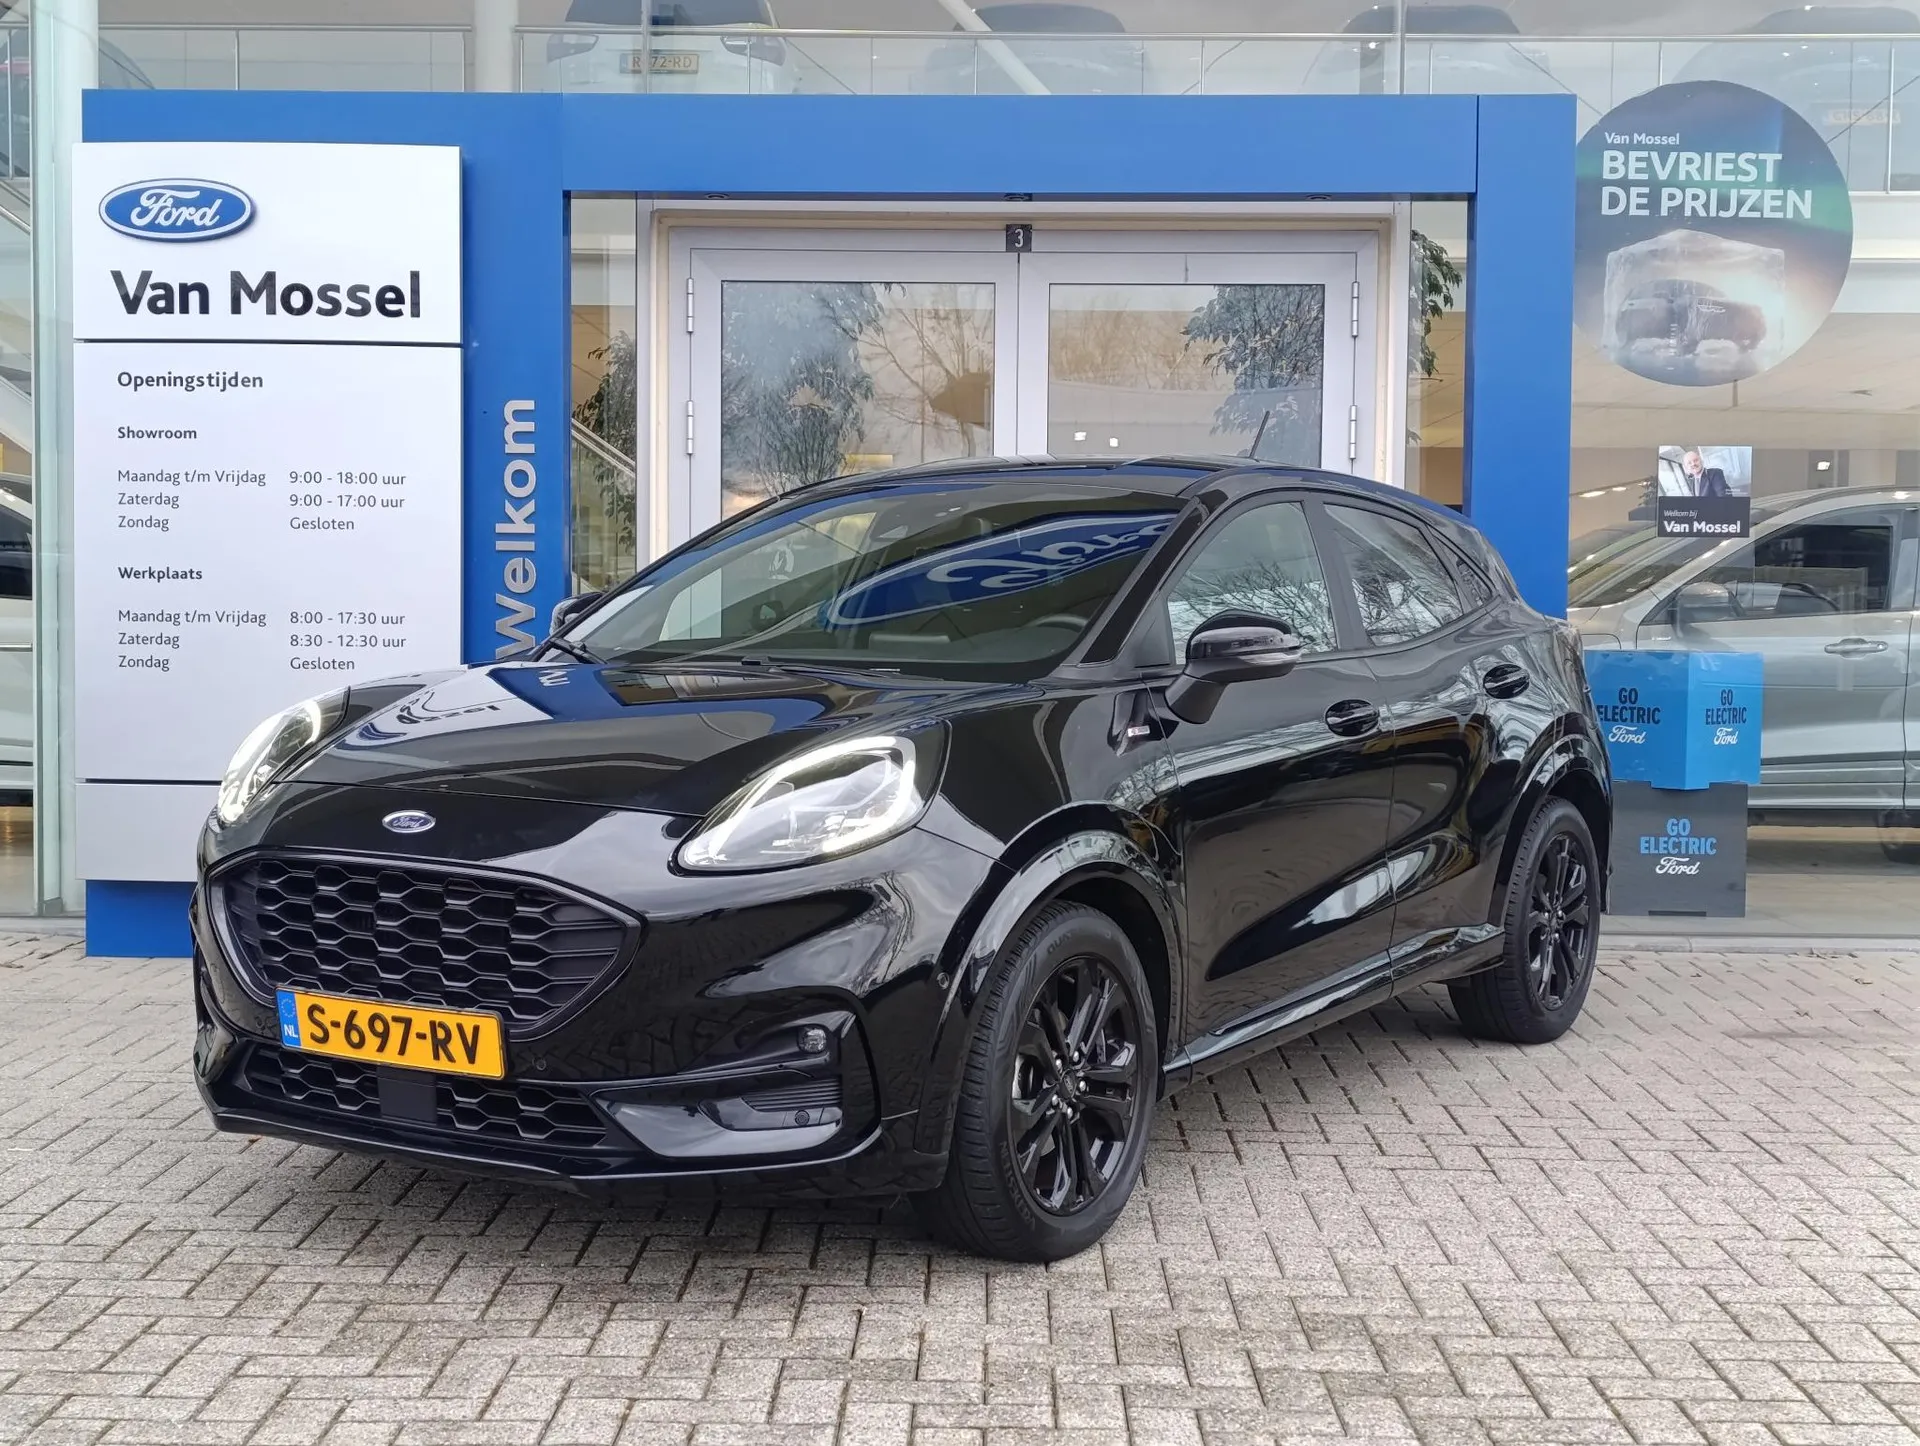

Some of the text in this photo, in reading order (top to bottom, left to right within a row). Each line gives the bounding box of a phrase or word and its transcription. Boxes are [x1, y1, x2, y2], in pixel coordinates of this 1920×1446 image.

[1604, 132, 1680, 145] Van Mossel
[1602, 150, 1783, 183] BEVRIEST
[130, 189, 223, 227] Ford
[1601, 186, 1813, 219] DE PRIJZEN
[1014, 228, 1024, 248] 3
[109, 269, 421, 319] Van Mossel
[116, 370, 264, 390] Openingstijden
[117, 425, 198, 441] Showroom
[117, 468, 181, 487] Maandag
[183, 469, 211, 485] t/m
[214, 469, 267, 489] Vrijdag
[288, 470, 323, 486] 9:00
[336, 471, 378, 486] 18:00
[382, 474, 407, 486] uur
[117, 491, 181, 509] Zaterdag
[288, 493, 323, 508] 9:00
[336, 494, 377, 508] 17:00
[381, 498, 406, 509] uur
[117, 514, 356, 533] Zondag Gesloten
[494, 398, 538, 660] Welkom
[1663, 520, 1741, 534] Van Mossel
[117, 565, 204, 582] Werkplaats
[117, 608, 181, 627] Maandag
[183, 609, 211, 625] t/m
[214, 609, 268, 629] Vrijdag
[289, 610, 324, 626] 8:00
[337, 611, 377, 626] 17:30
[381, 614, 406, 626] uur
[117, 631, 181, 650] Zaterdag
[289, 633, 323, 648] 8:30
[336, 634, 379, 648] 12:30
[382, 637, 407, 649] uur
[117, 654, 356, 673] Zondag Gesloten
[1618, 687, 1639, 705] GO
[1720, 688, 1734, 706] GO
[1597, 705, 1661, 725] ELECTRIC
[1705, 706, 1747, 726] ELECTRIC
[1608, 724, 1647, 745] Ford
[1713, 727, 1739, 745] Ford
[1666, 818, 1691, 837] GO
[1640, 836, 1717, 855] ELECTRIC
[1655, 856, 1701, 875] Ford
[283, 1023, 299, 1039] NL
[307, 1003, 481, 1065] S-697-RV
